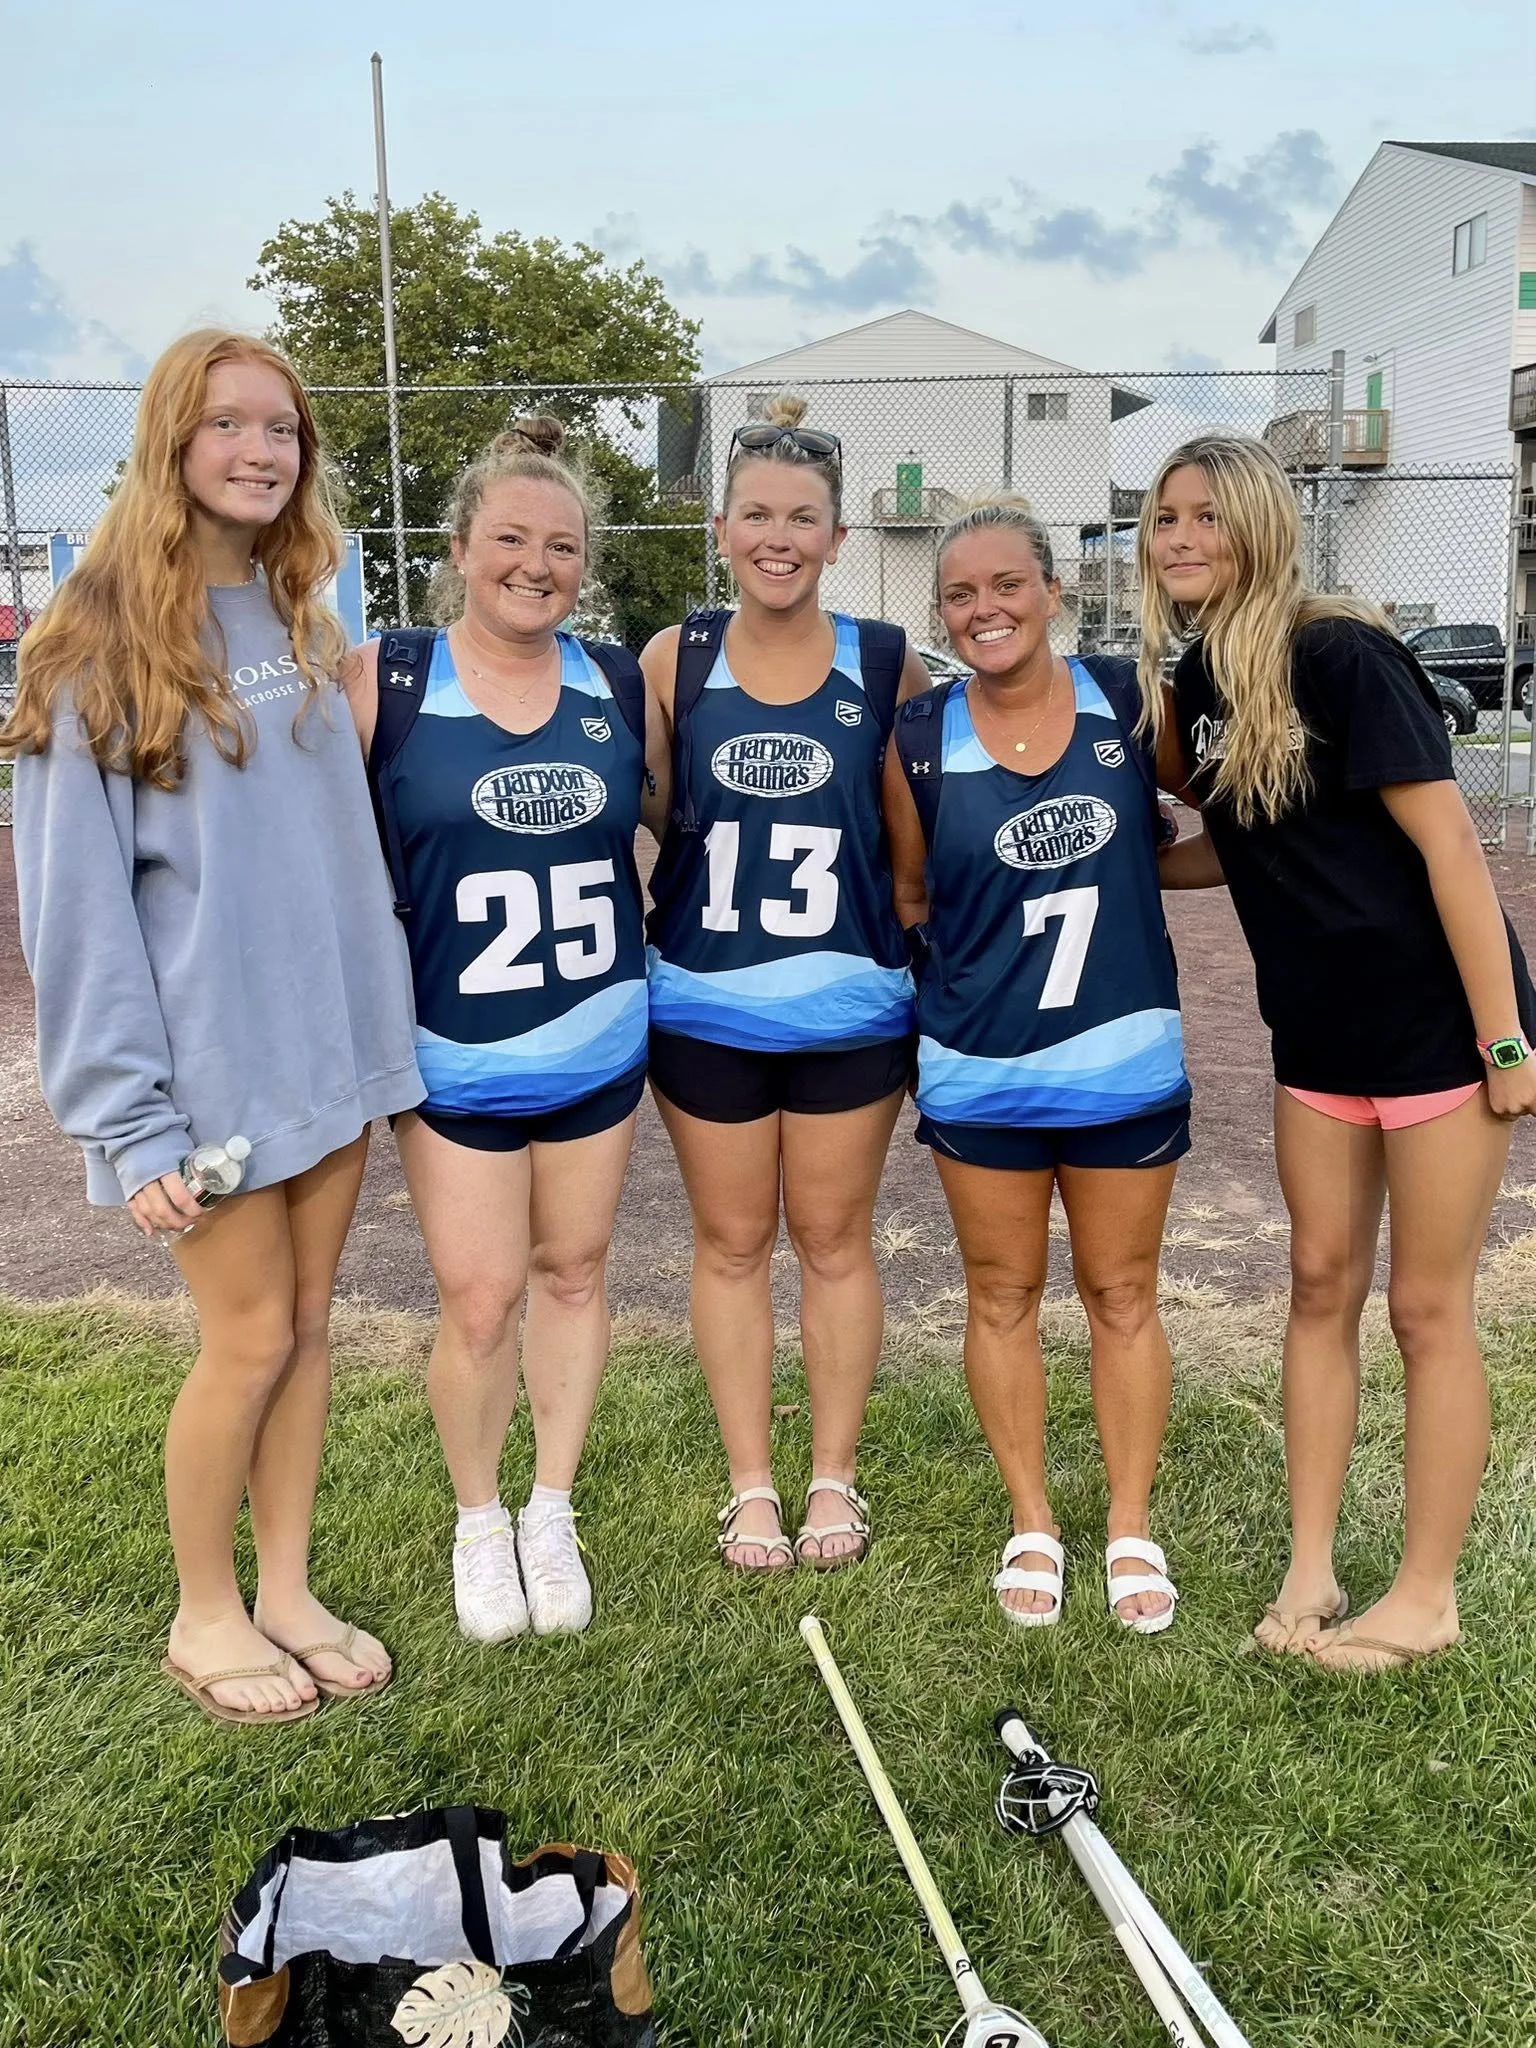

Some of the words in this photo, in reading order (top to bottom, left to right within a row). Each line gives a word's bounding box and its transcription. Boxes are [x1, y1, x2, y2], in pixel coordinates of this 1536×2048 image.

[236, 683, 296, 711] LACROSSE
[727, 738, 814, 761] Harpoon
[490, 768, 586, 797] Harpoon
[1010, 801, 1094, 842] Harpoon
[701, 821, 842, 937] 13
[456, 858, 616, 994] 25
[1022, 886, 1099, 1010] 7
